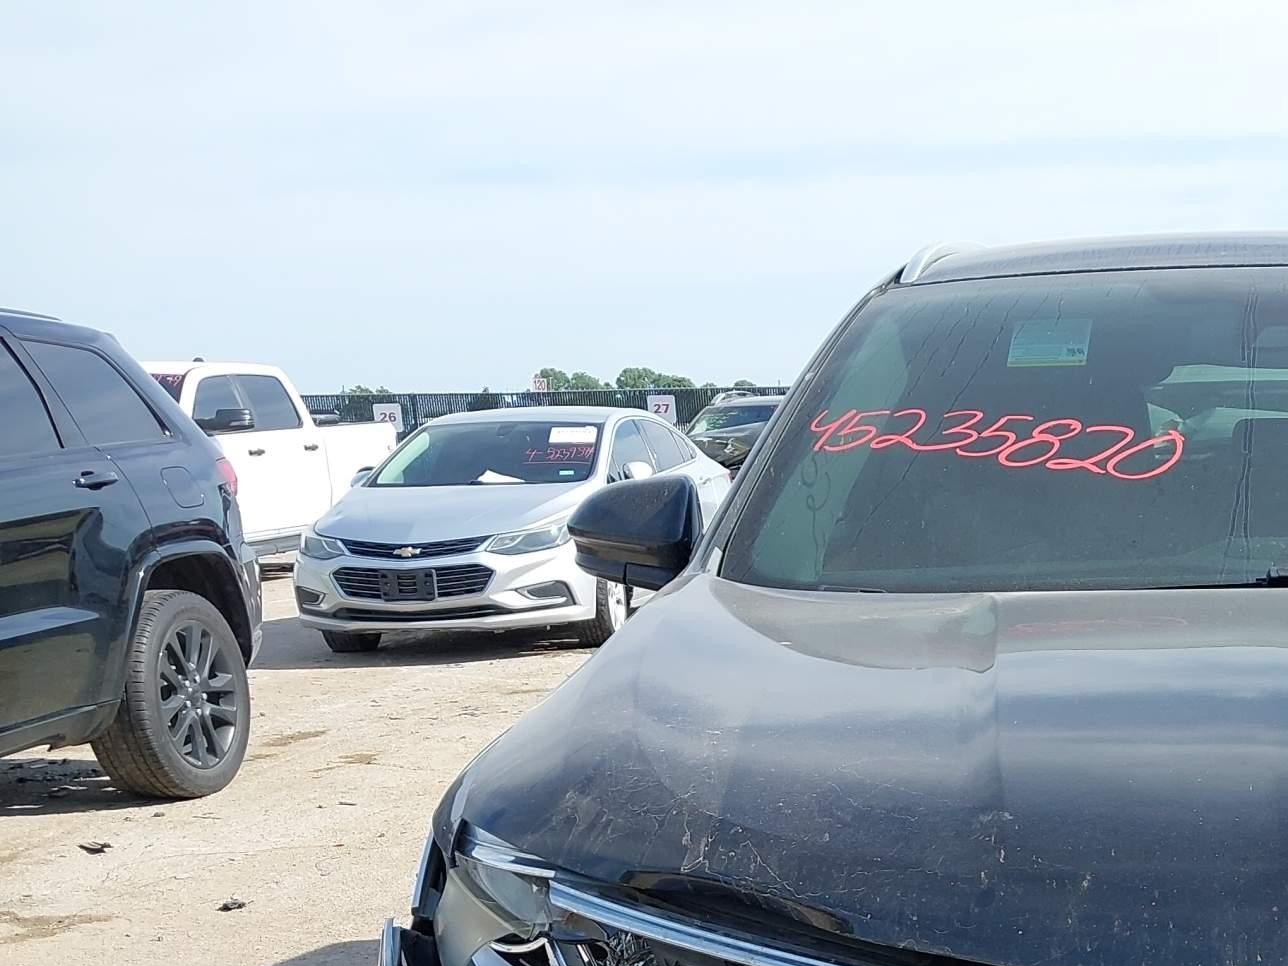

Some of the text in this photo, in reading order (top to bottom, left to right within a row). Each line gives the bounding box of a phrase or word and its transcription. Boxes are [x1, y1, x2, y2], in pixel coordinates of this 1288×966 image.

[653, 403, 670, 414] 27
[379, 412, 397, 423] 26
[810, 409, 1185, 479] 45235820
